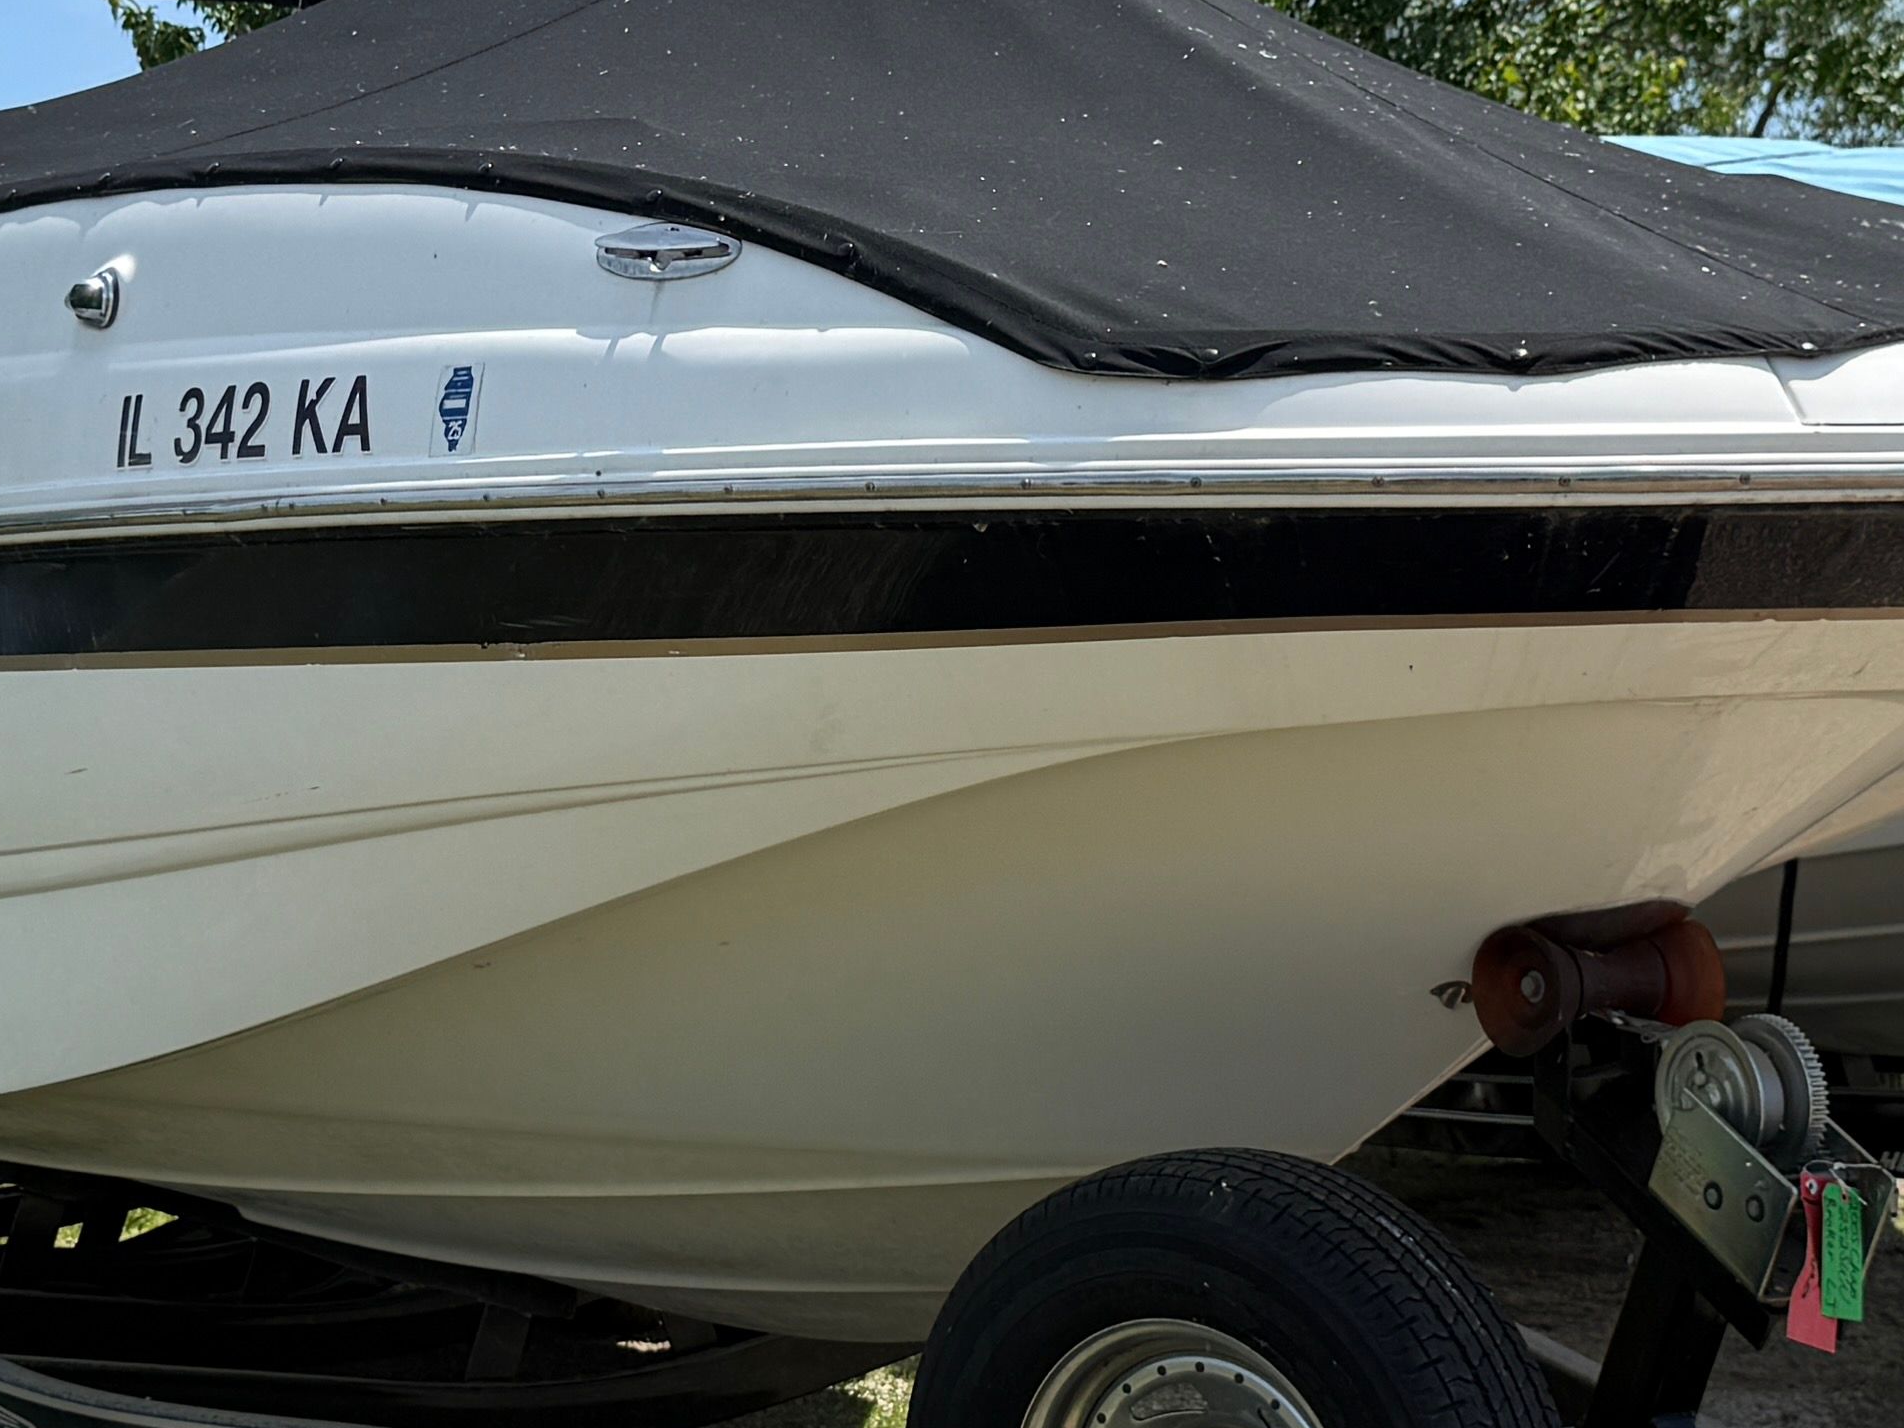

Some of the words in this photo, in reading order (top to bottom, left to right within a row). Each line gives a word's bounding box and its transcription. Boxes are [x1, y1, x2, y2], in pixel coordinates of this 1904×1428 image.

[116, 394, 151, 468] IL
[174, 382, 270, 464] 342
[291, 375, 371, 456] KA
